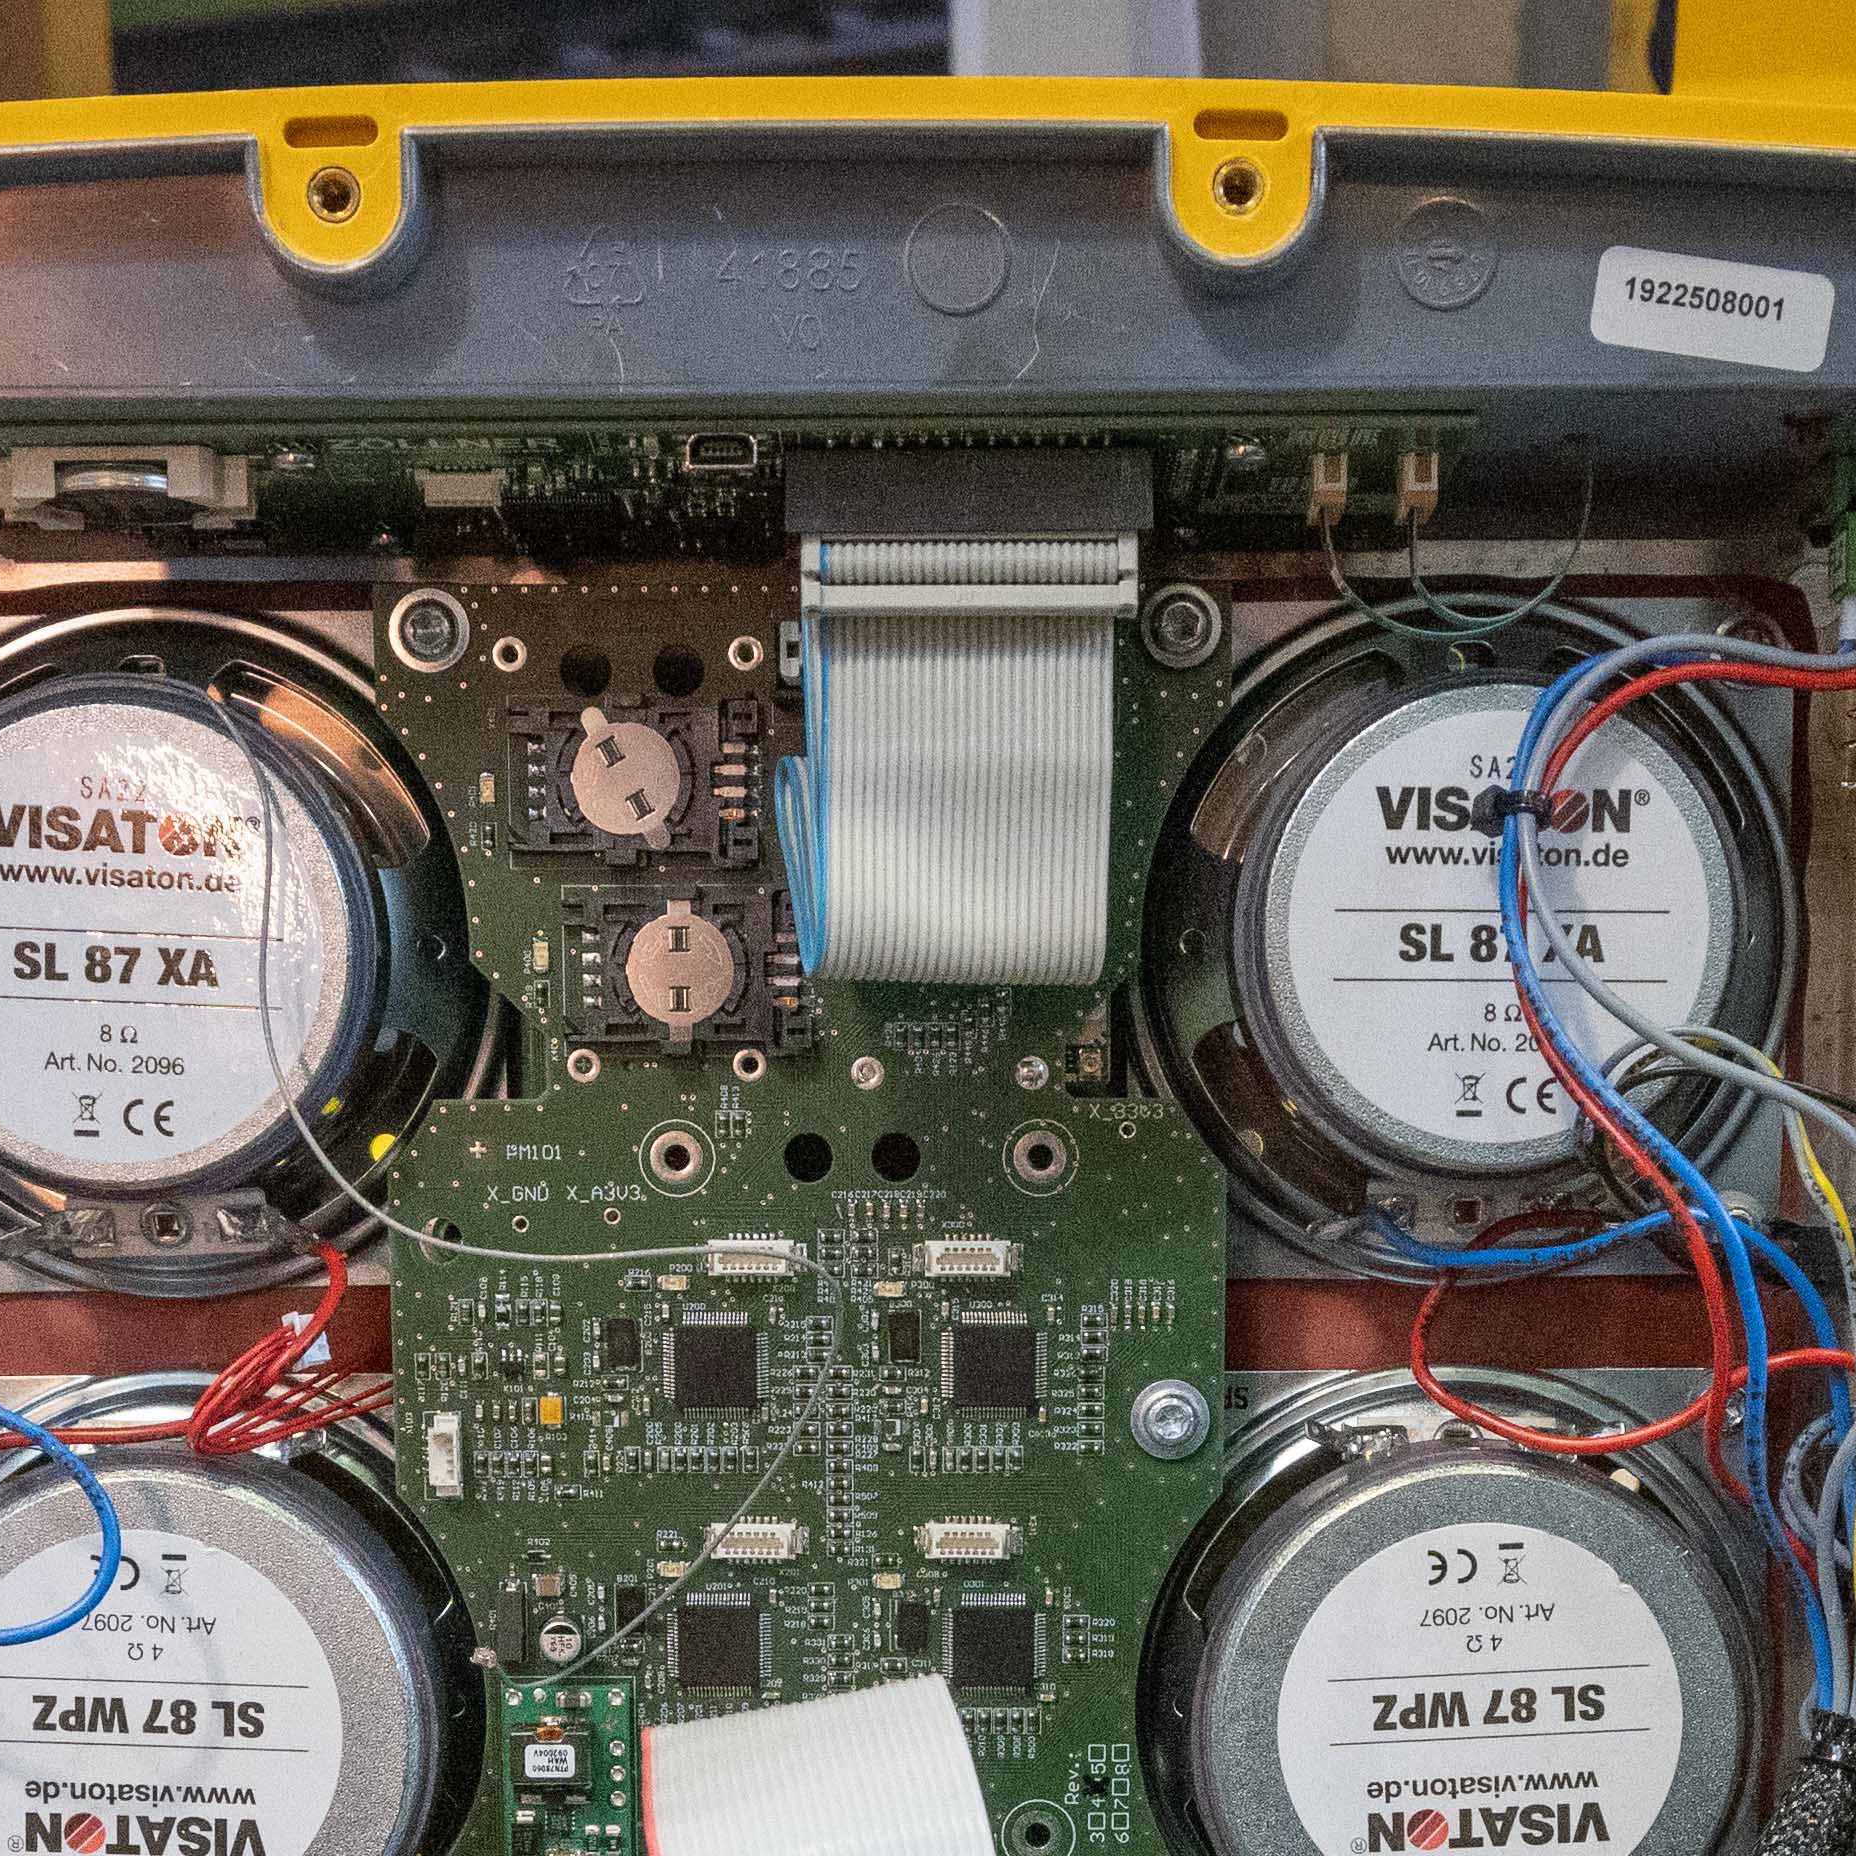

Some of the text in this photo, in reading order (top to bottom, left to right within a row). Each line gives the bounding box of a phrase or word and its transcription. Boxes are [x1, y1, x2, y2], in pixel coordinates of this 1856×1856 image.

[716, 247, 863, 292] 41885
[1624, 276, 1787, 323] 1922508001
[0, 862, 243, 895] www.visaton.de
[1399, 923, 1454, 962] SL
[13, 940, 220, 989] SL 87 XA
[1484, 1003, 1496, 1022] 8
[99, 1023, 140, 1045] 8 Ω
[1428, 1033, 1464, 1052] Art.
[1470, 1033, 1508, 1052] No.
[44, 1050, 186, 1076] Art. No. 2096
[506, 1144, 562, 1161] PM101
[487, 1184, 550, 1205] X_GND
[566, 1184, 641, 1204] X_A3V3
[82, 1611, 217, 1635] Art. No. 2097
[1420, 1602, 1556, 1629] Art. No. 2097
[152, 1642, 164, 1661] 4
[1491, 1633, 1503, 1652] 4
[31, 1694, 265, 1738] SL 87 WPZ
[1373, 1684, 1606, 1730] SL 87 WPZ
[24, 1779, 256, 1806] www.visaton.de
[1367, 1770, 1599, 1800] www.visaton.de
[1089, 1832, 1105, 1844] 3
[1114, 1832, 1130, 1844] 6
